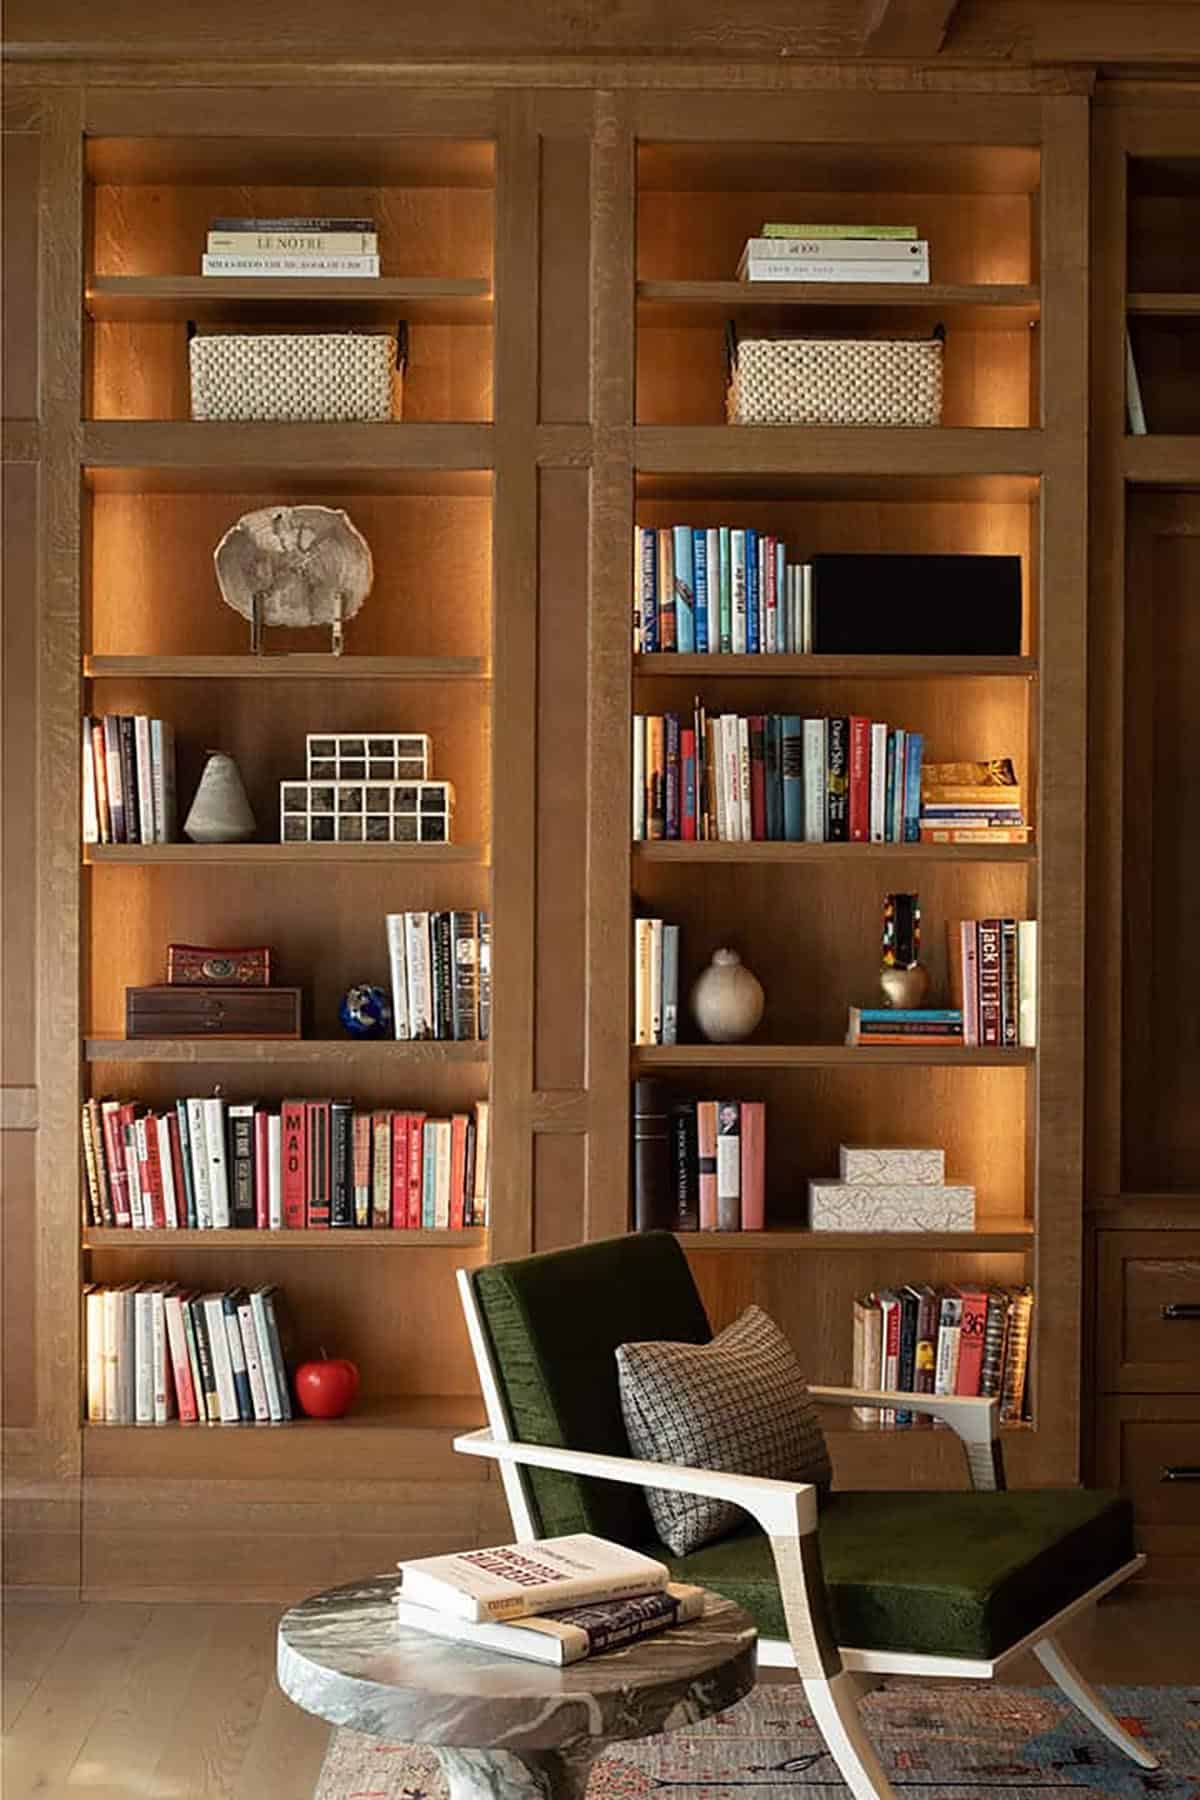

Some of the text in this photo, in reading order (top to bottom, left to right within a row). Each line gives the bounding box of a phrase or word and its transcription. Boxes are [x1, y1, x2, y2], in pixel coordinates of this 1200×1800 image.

[257, 238, 273, 249] LE
[286, 1115, 301, 1173] MAO
[962, 1312, 985, 1336] 36
